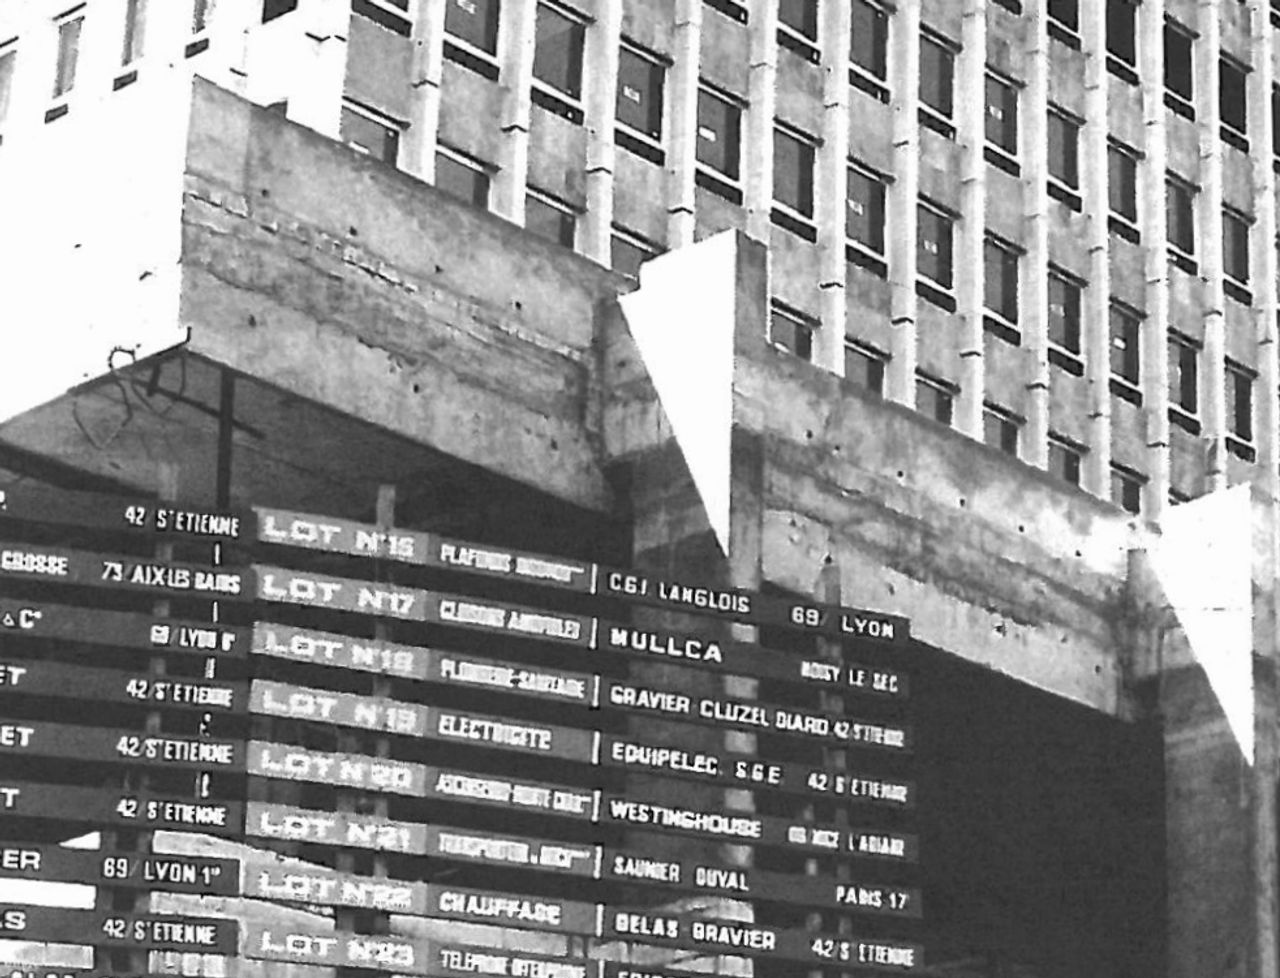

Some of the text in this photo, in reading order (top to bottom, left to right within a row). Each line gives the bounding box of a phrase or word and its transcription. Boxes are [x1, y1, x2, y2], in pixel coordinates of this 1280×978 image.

[264, 516, 342, 544] LOT
[263, 574, 342, 602] LOT
[660, 582, 750, 613] LANGLOIS
[842, 616, 894, 638] LYON
[265, 631, 343, 659] LOT
[611, 628, 723, 662] MULLCA
[849, 669, 865, 686] LE
[263, 690, 338, 717] LOT
[611, 686, 690, 714] GRAVIER
[700, 700, 770, 727] CLUZEL
[261, 750, 334, 777] LOT
[260, 811, 336, 838] LOT
[611, 800, 761, 838] WESTINGHOUSE
[145, 860, 196, 883] LYON
[697, 868, 749, 891] DUVAL
[260, 871, 337, 900] LOT
[836, 885, 882, 907] PARIS
[439, 891, 561, 925] CHAUFFAGE
[262, 931, 338, 957] LOT
